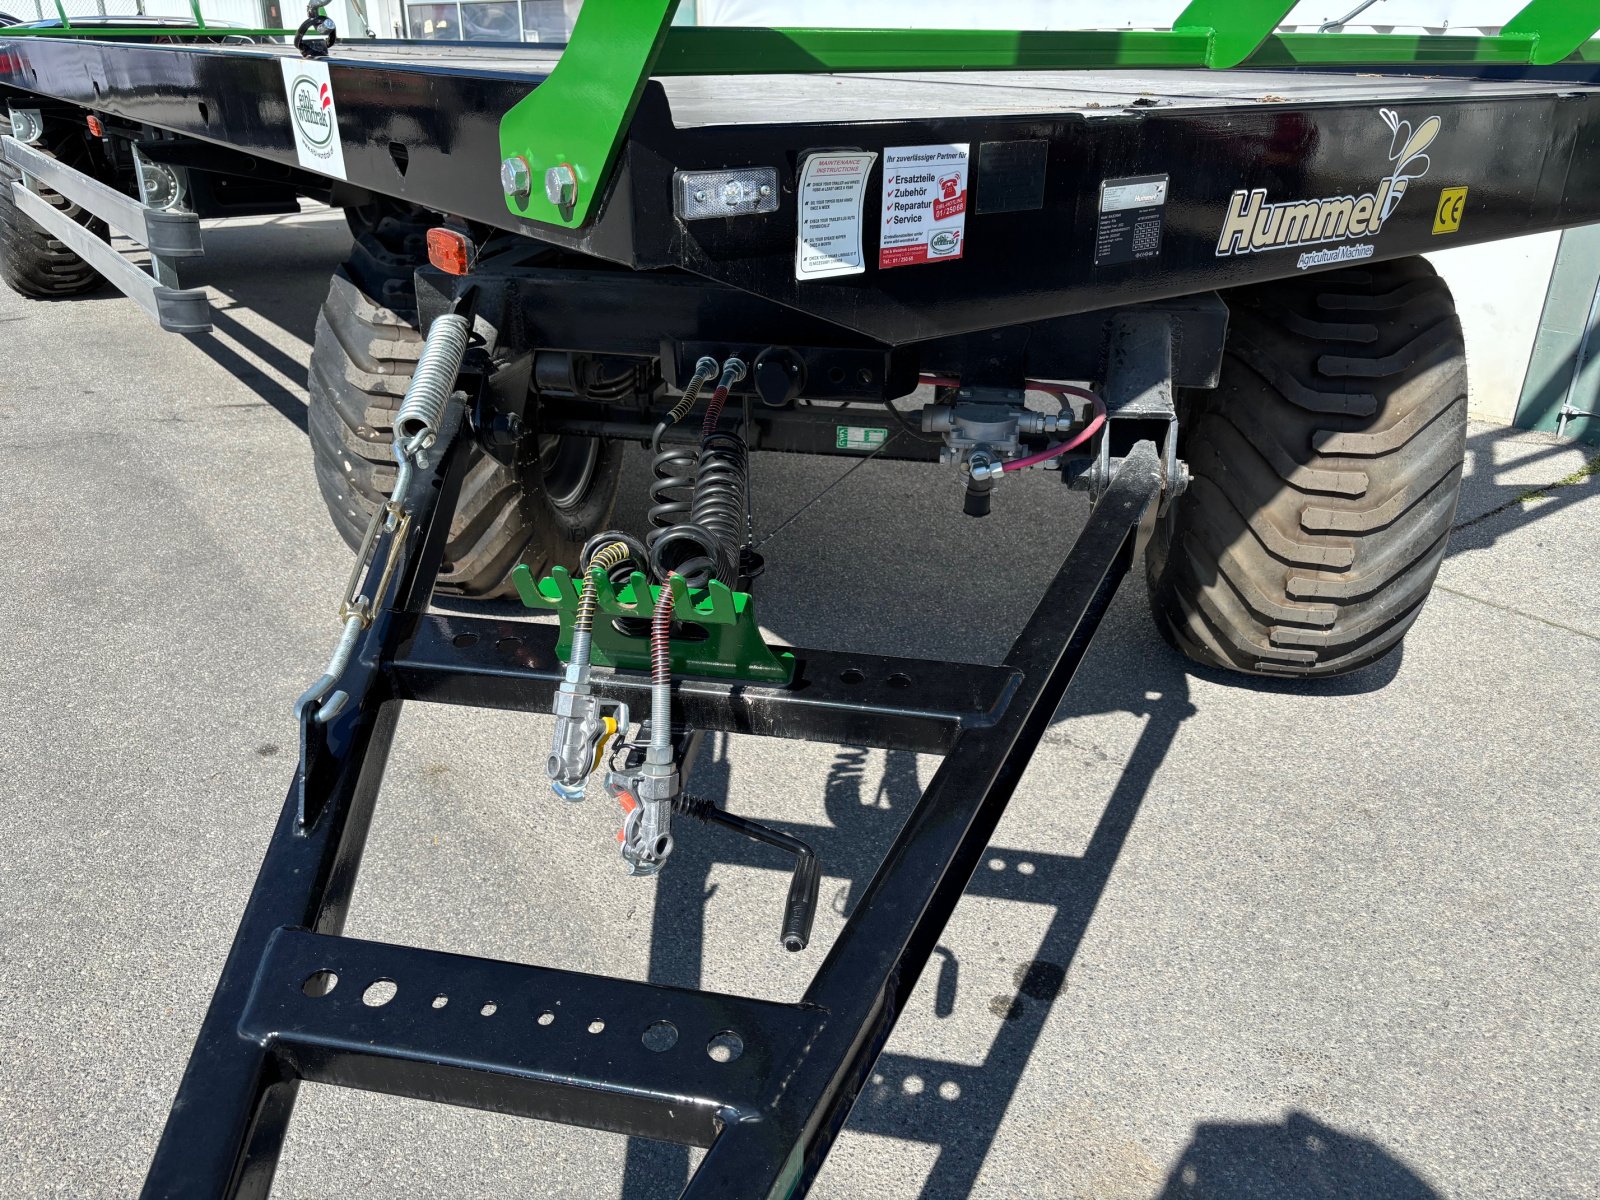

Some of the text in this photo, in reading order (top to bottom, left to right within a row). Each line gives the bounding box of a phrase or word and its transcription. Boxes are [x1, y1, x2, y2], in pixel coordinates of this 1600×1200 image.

[297, 106, 328, 128] wondrak
[886, 151, 967, 163] Ihr zuverlässiger Partner für
[895, 173, 936, 185] Ersatzteile
[894, 187, 927, 198] Zubehör
[894, 201, 932, 212] Reparatur
[893, 214, 922, 225] Service
[1216, 177, 1392, 257] Hummel
[1297, 243, 1375, 269] Agricultural Machines
